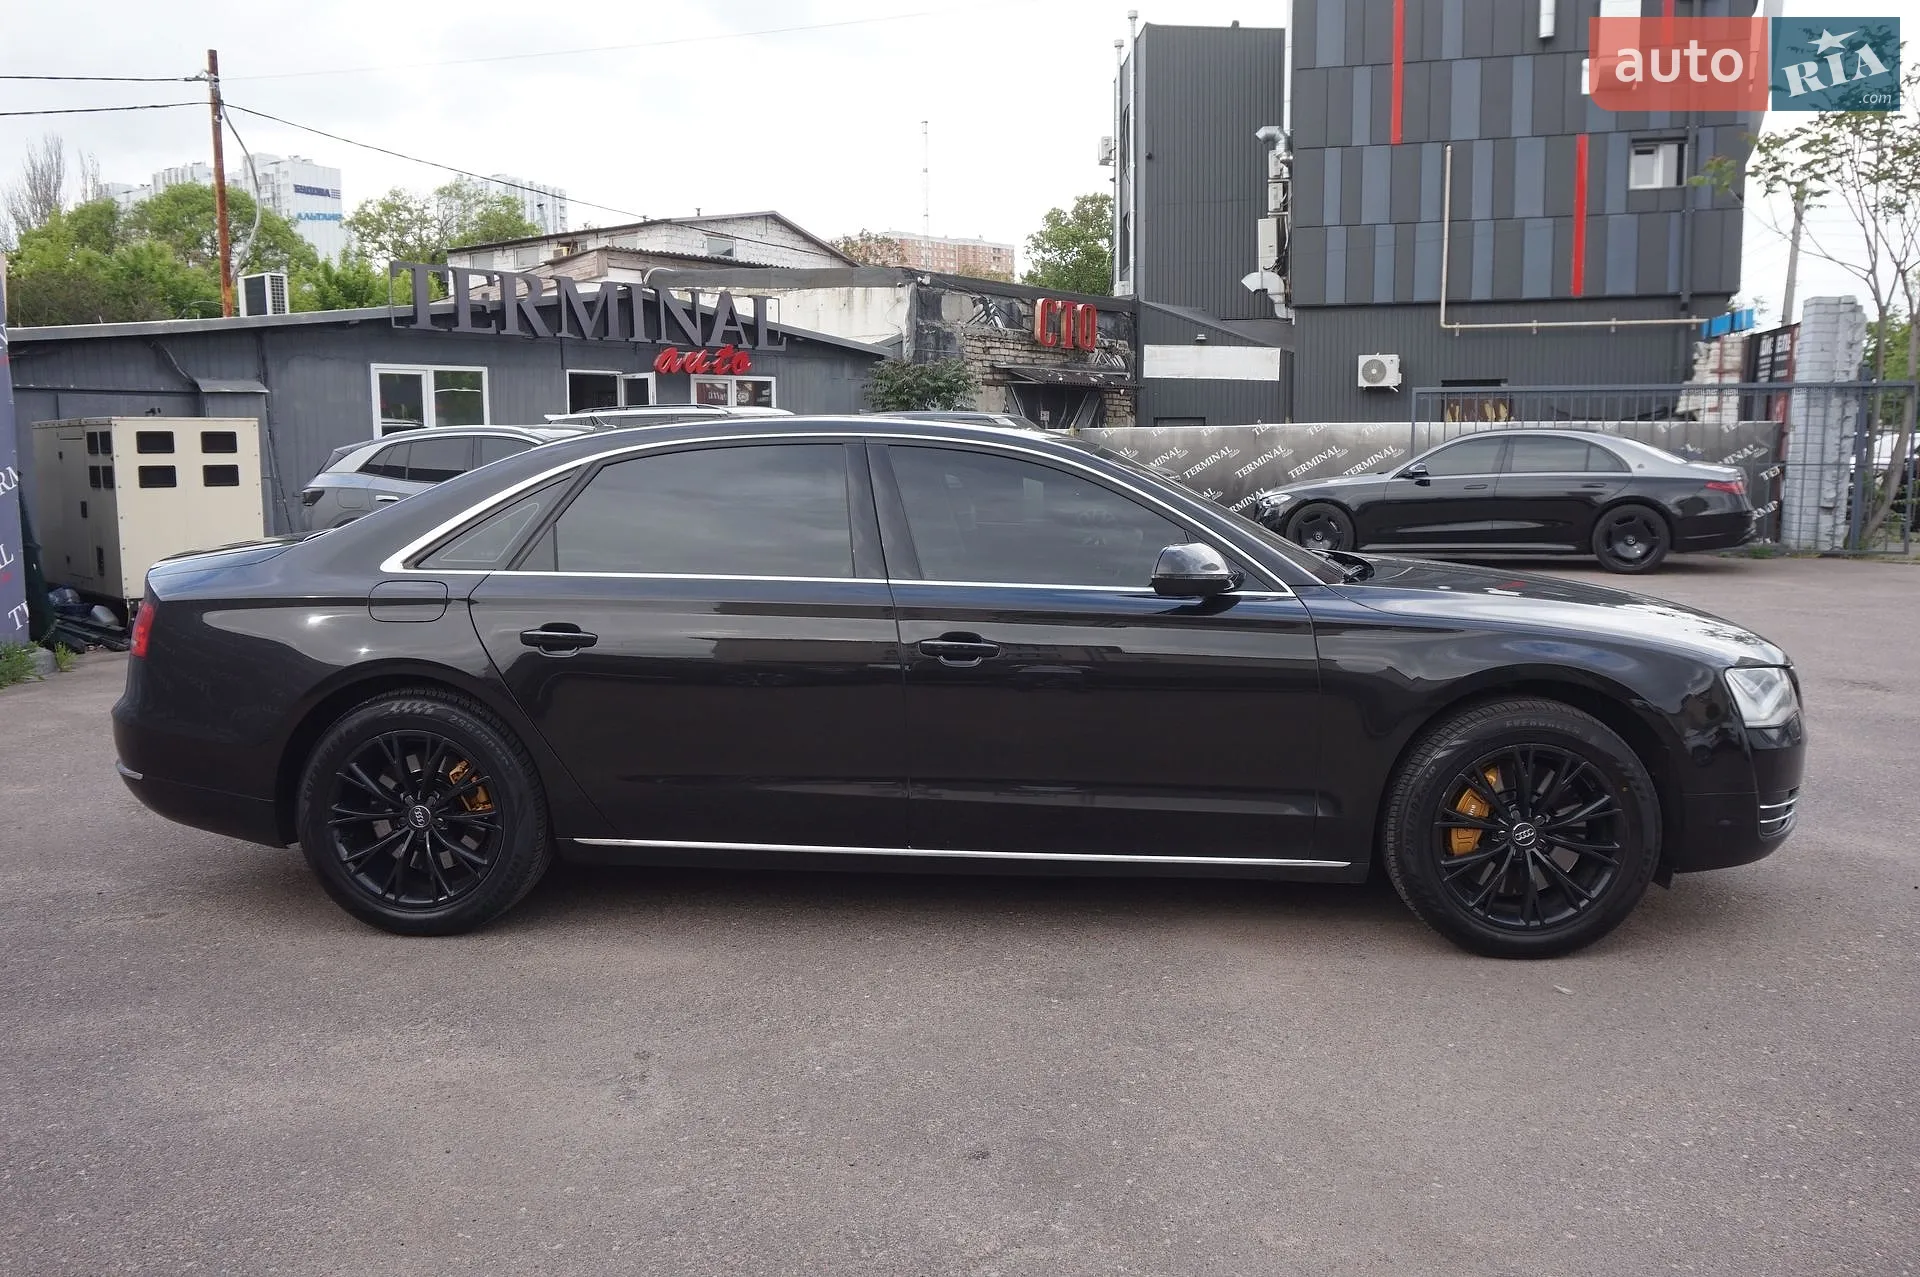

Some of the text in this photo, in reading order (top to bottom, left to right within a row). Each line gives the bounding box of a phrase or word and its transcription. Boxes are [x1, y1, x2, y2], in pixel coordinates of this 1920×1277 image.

[389, 261, 786, 351] TERMINAL
[654, 344, 752, 374] auto
[1183, 446, 1233, 479] TERMINAL
[1234, 445, 1286, 479] TERMINAL
[1288, 445, 1341, 479] TERMINAL
[1343, 445, 1397, 476] TERMINAL
